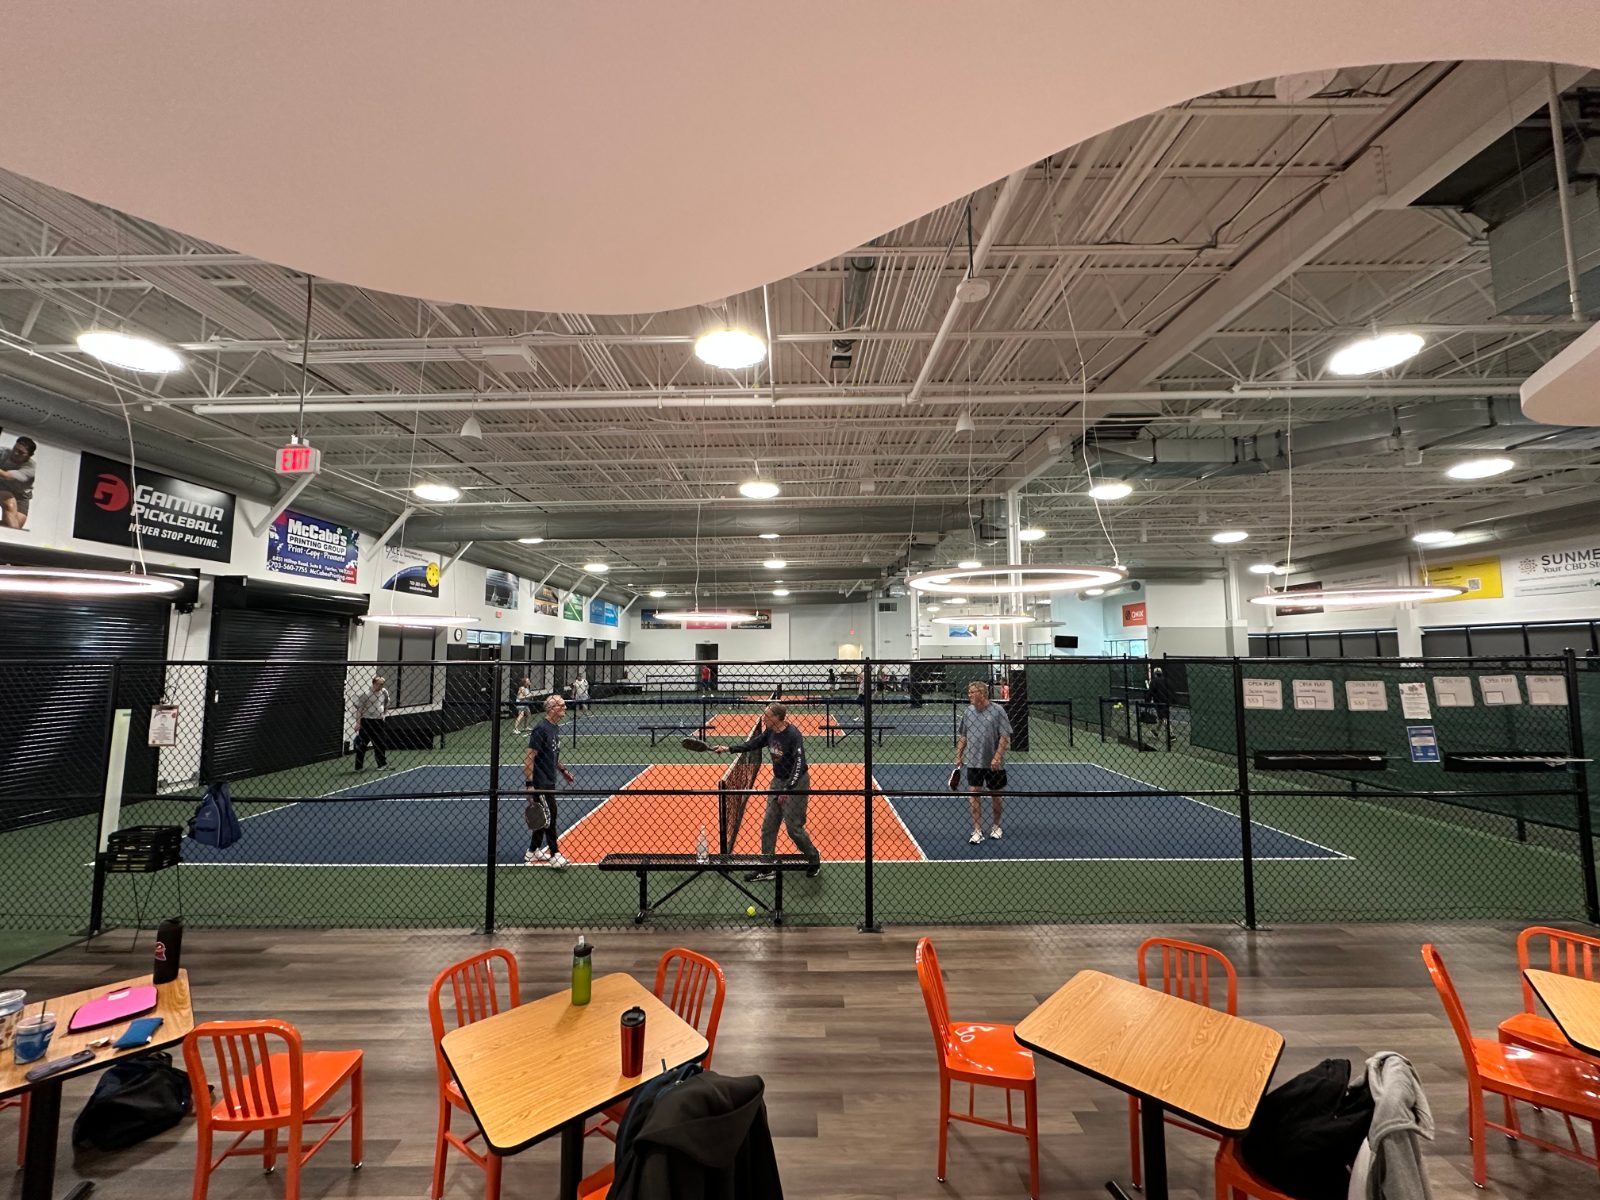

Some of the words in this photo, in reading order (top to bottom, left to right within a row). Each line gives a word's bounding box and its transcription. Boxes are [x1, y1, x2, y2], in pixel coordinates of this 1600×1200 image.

[281, 449, 311, 471] EXIT
[135, 484, 225, 521] GAMMA
[128, 523, 159, 537] NEVER
[161, 529, 184, 541] STOP
[288, 519, 347, 546] McCabe's
[288, 544, 303, 554] Print
[305, 548, 320, 560] Copy
[323, 552, 345, 562] Promote
[289, 536, 322, 549] PRINTING
[323, 544, 345, 554] GROUP
[1541, 548, 1600, 566] SUNME
[1564, 562, 1587, 571] CBD
